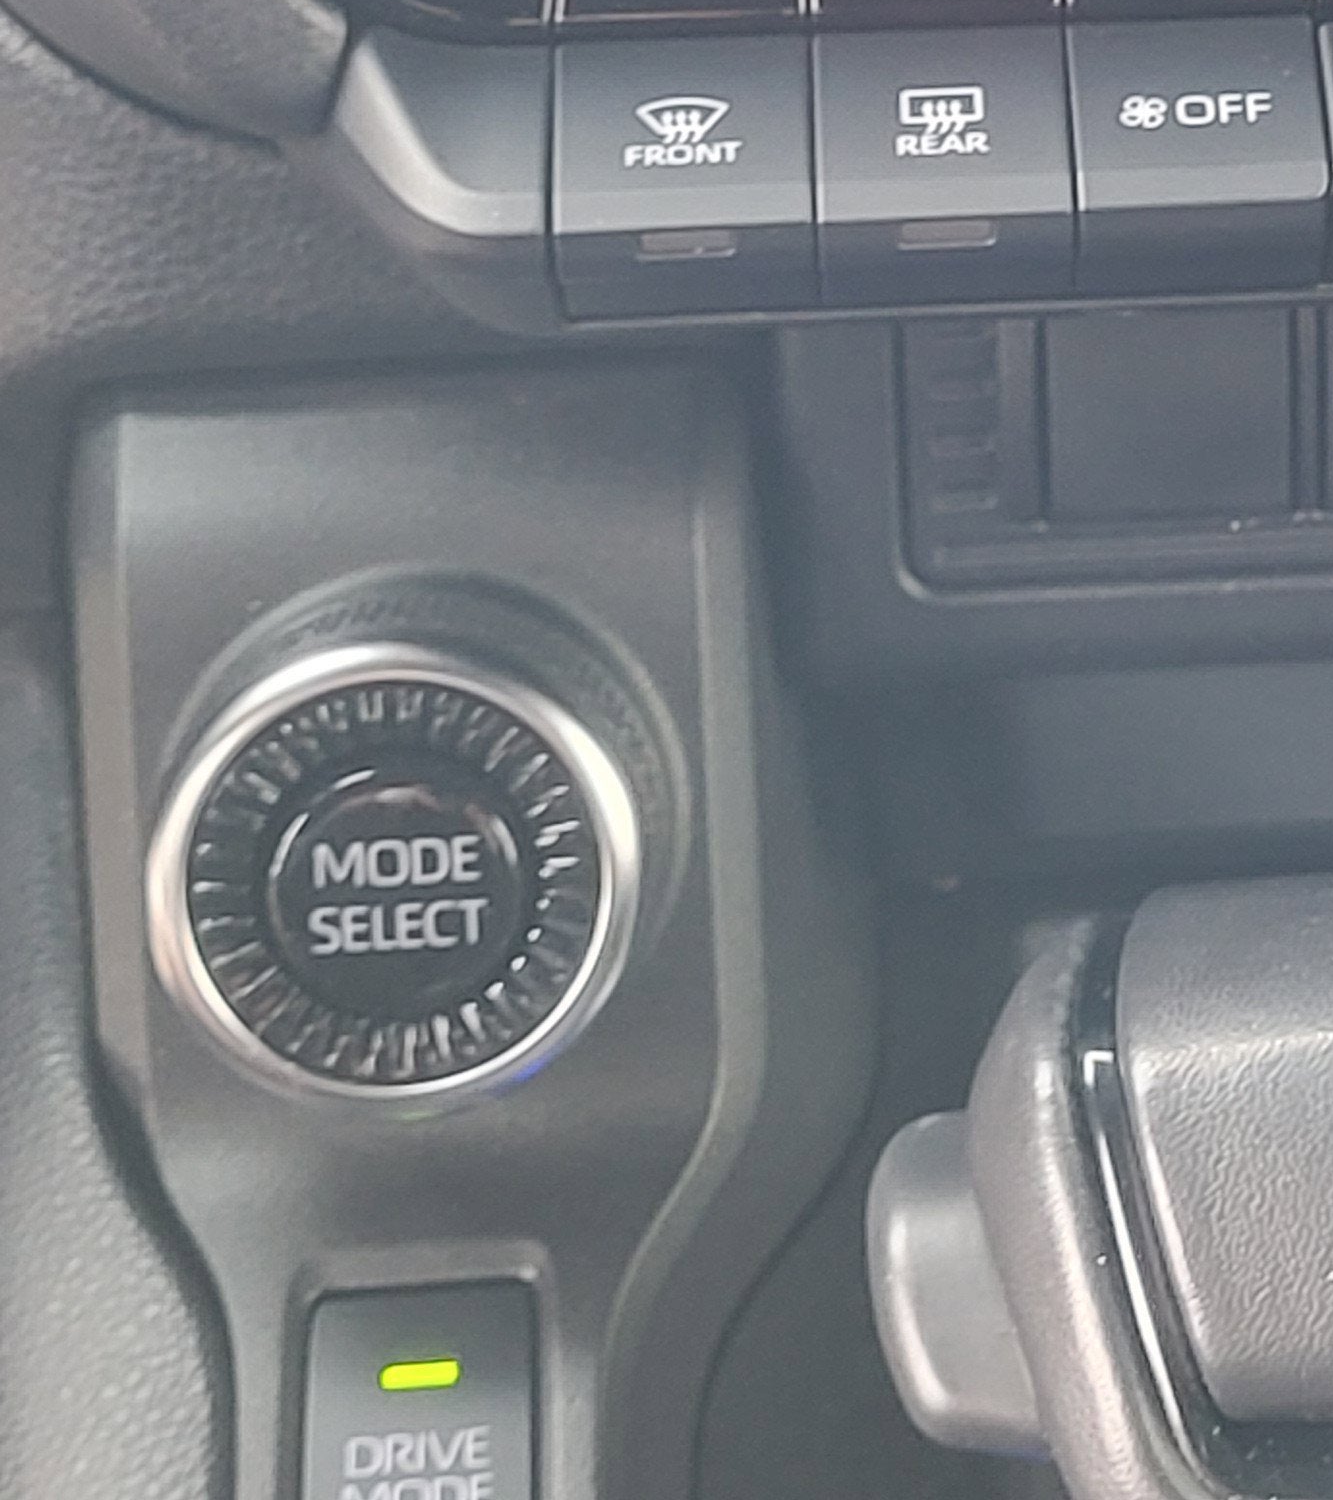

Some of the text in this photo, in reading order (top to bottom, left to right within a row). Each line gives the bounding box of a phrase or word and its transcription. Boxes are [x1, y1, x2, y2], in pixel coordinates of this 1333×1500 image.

[1175, 93, 1273, 127] OFF
[623, 141, 742, 167] FRONT
[896, 131, 989, 157] REAR
[311, 835, 482, 889] MODE
[306, 898, 489, 955] SELECT
[343, 1425, 491, 1479] DRIVE
